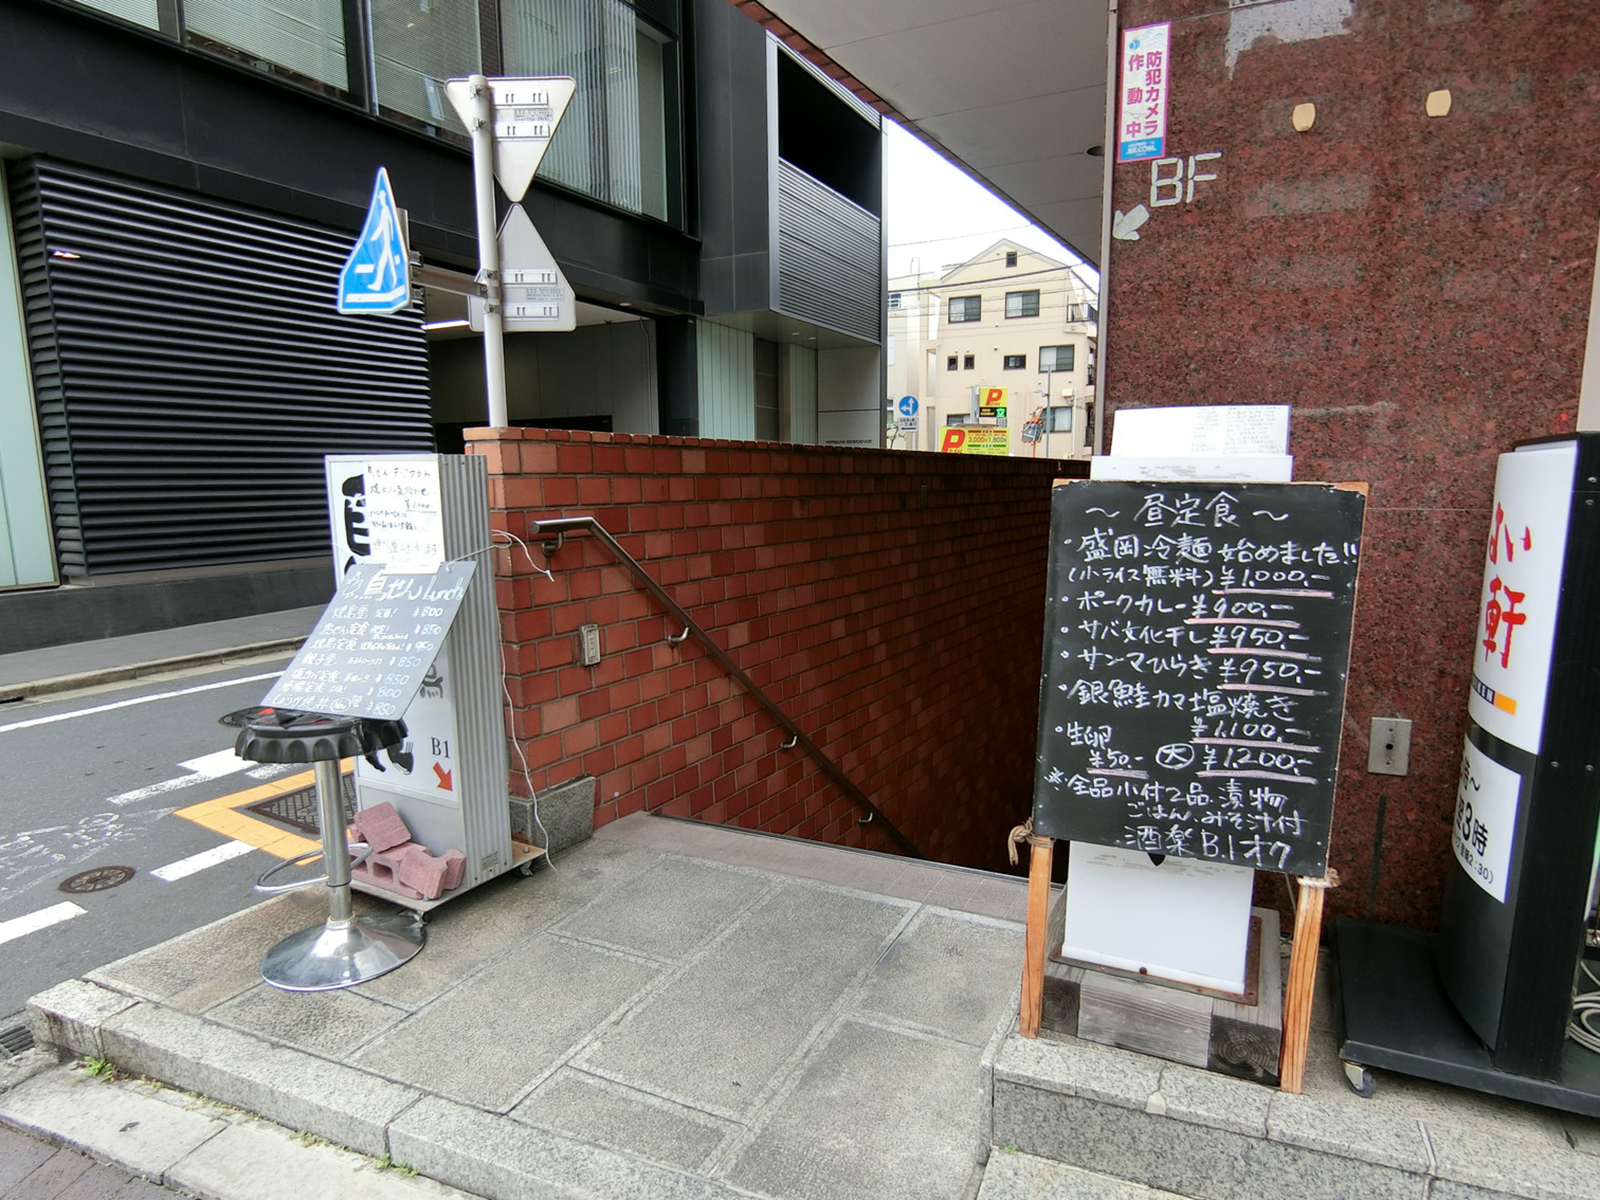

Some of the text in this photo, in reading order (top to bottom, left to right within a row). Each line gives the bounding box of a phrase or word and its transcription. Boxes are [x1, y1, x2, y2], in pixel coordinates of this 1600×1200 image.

[1126, 54, 1144, 138] 作動中
[1144, 51, 1162, 136] 防犯カメラ
[1150, 152, 1222, 207] BF
[985, 389, 1003, 405] P
[1076, 590, 1187, 616] ポークカレー
[1078, 620, 1208, 647] サバ文化干し
[1077, 646, 1212, 680] サンマひらき
[431, 737, 451, 758] B1
[1067, 721, 1112, 749] 生卵
